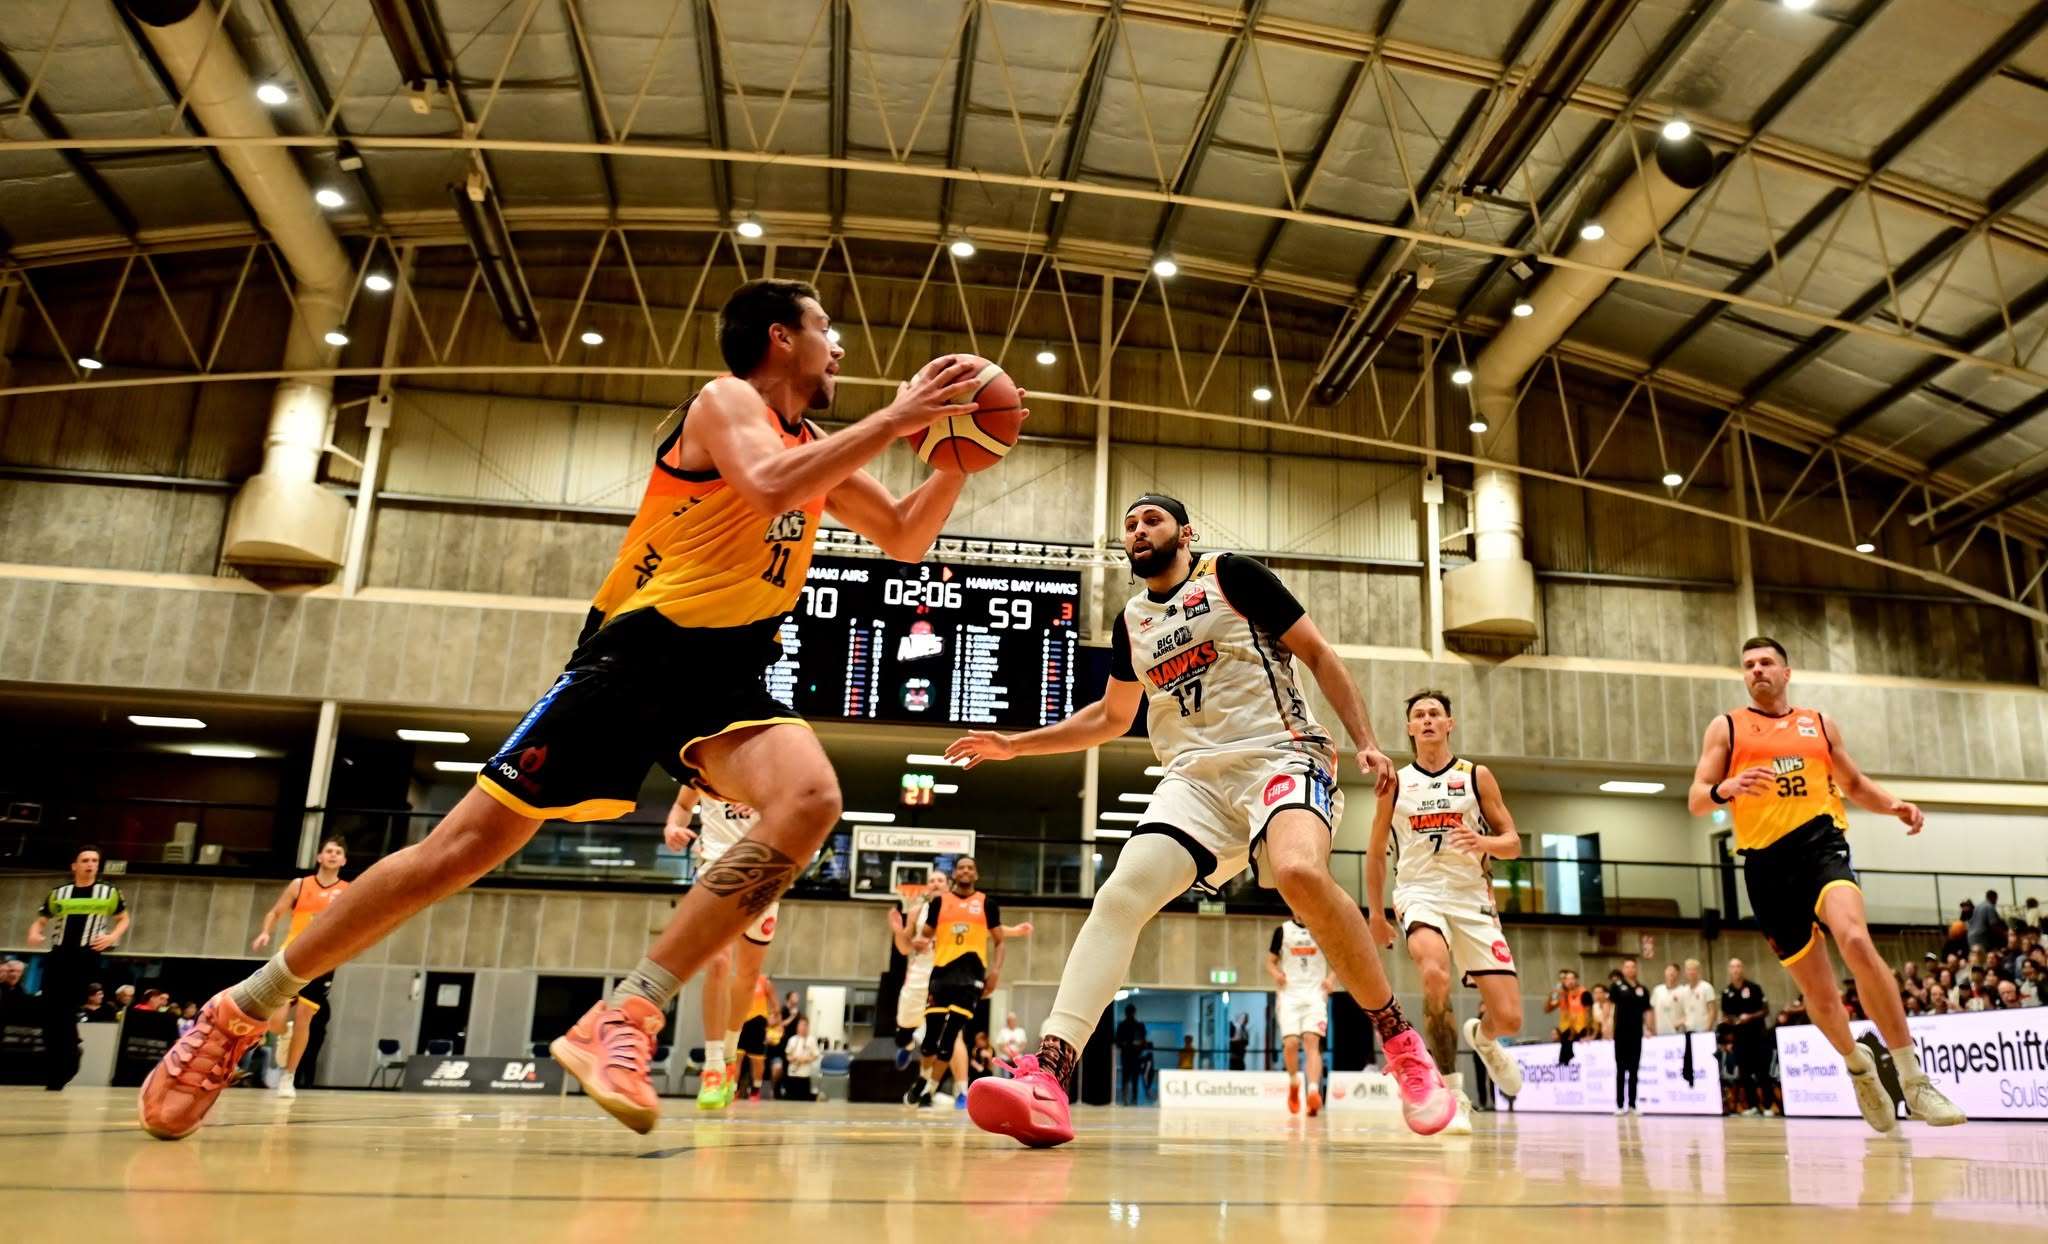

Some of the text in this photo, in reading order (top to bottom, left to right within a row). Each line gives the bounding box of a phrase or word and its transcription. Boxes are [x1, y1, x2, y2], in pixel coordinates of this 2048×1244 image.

[761, 543, 790, 588] 11
[920, 566, 929, 580] 3
[840, 569, 869, 582] AIRS
[884, 579, 962, 608] 02:06
[966, 577, 1078, 595] HAWKS BAY HAWKS
[989, 598, 1032, 630] 59
[1062, 603, 1072, 619] 3
[1157, 635, 1172, 649] BIG
[1153, 644, 1176, 659] BARREL
[1147, 641, 1218, 688] HAWKS
[1171, 679, 1202, 717] 17
[499, 763, 518, 779] POD
[1776, 776, 1808, 798] 32
[1429, 834, 1442, 855] 7
[955, 934, 964, 946] 0
[1912, 1029, 2048, 1083] hapeshift
[1786, 1063, 1839, 1080] New Plymouth
